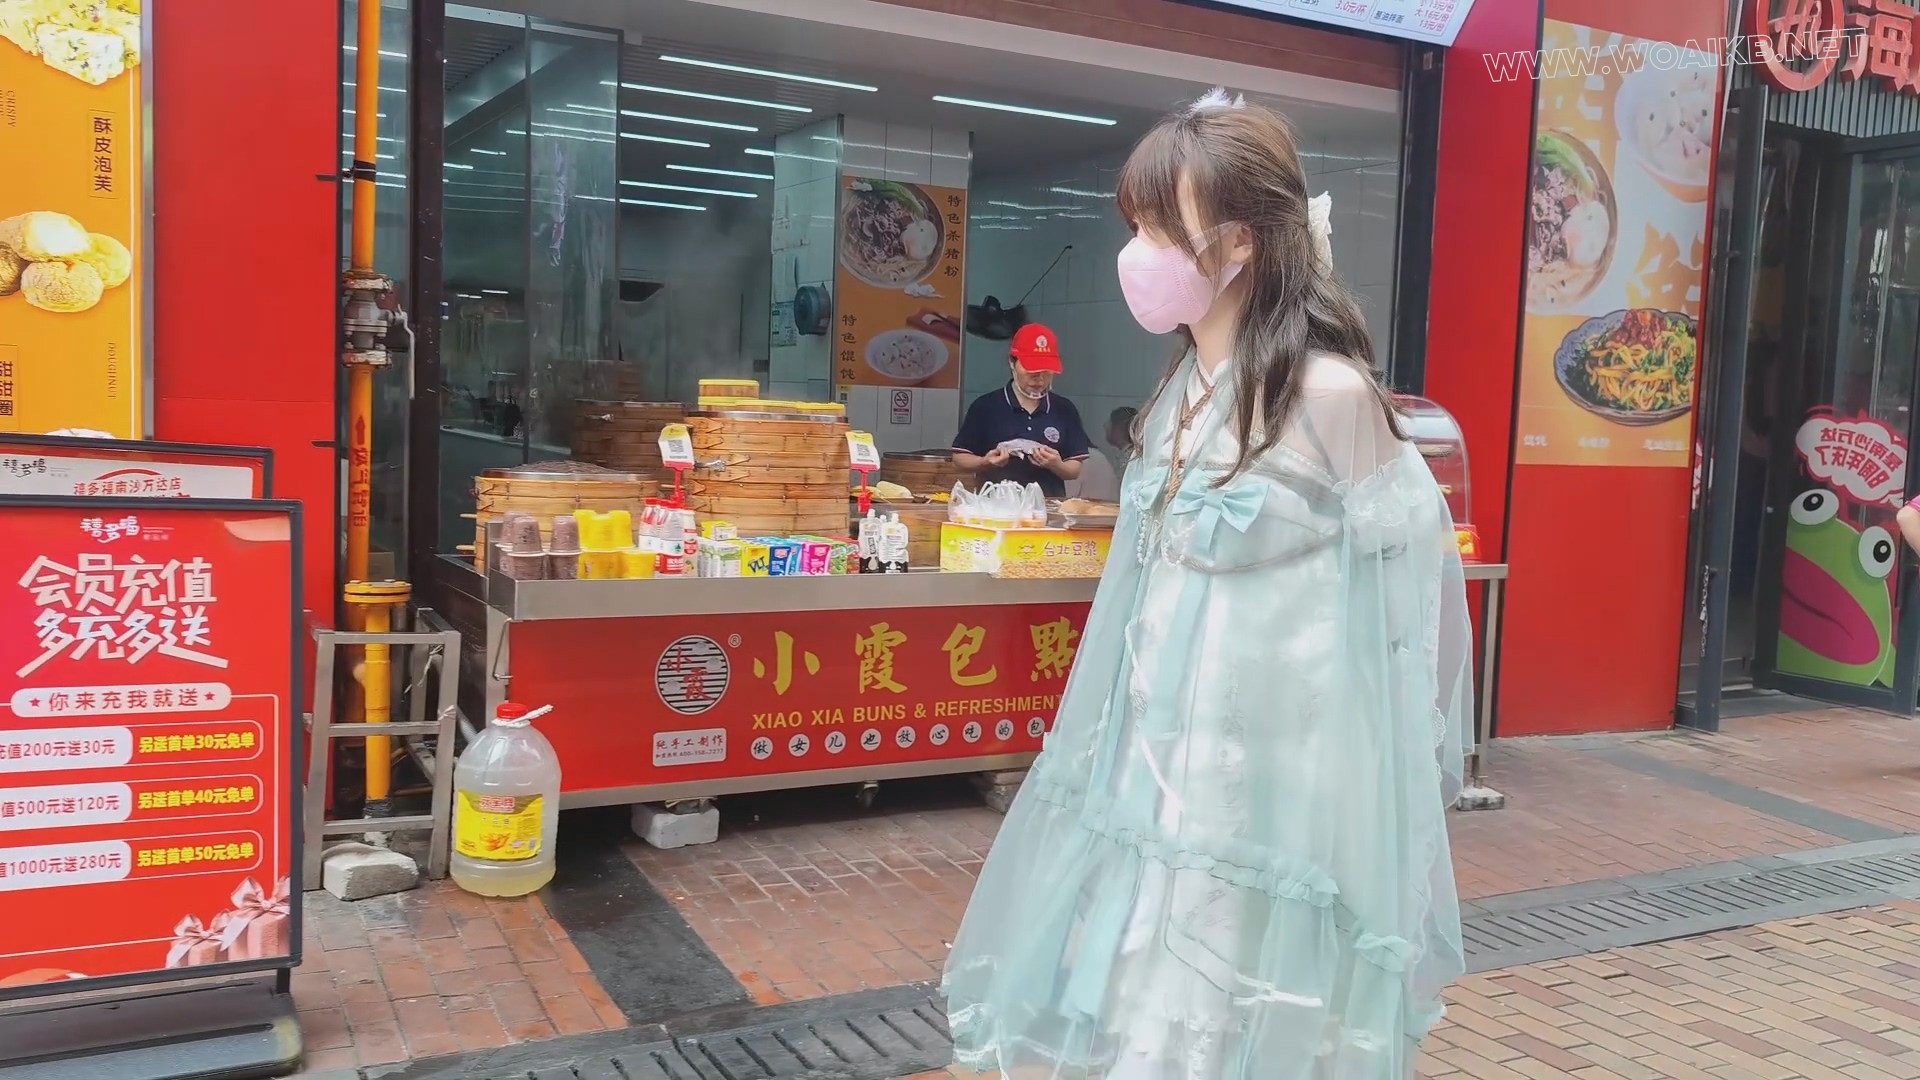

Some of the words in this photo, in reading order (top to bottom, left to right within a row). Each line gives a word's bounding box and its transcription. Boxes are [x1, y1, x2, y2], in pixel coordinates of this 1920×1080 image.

[93, 116, 113, 193] 酥皮泡芙
[1044, 540, 1097, 557] 台北豆浆
[18, 552, 217, 613] 会员充值
[16, 604, 229, 678] 多充多送
[49, 688, 199, 712] 你来充我就送
[752, 711, 802, 730] XIAO
[811, 708, 844, 725] XIA
[853, 704, 906, 723] BUNS
[914, 702, 926, 719] &
[139, 732, 255, 754] 另送首单30元免单
[137, 786, 255, 810] 另送首单40元免单
[137, 842, 255, 867] 另送首单50元免单
